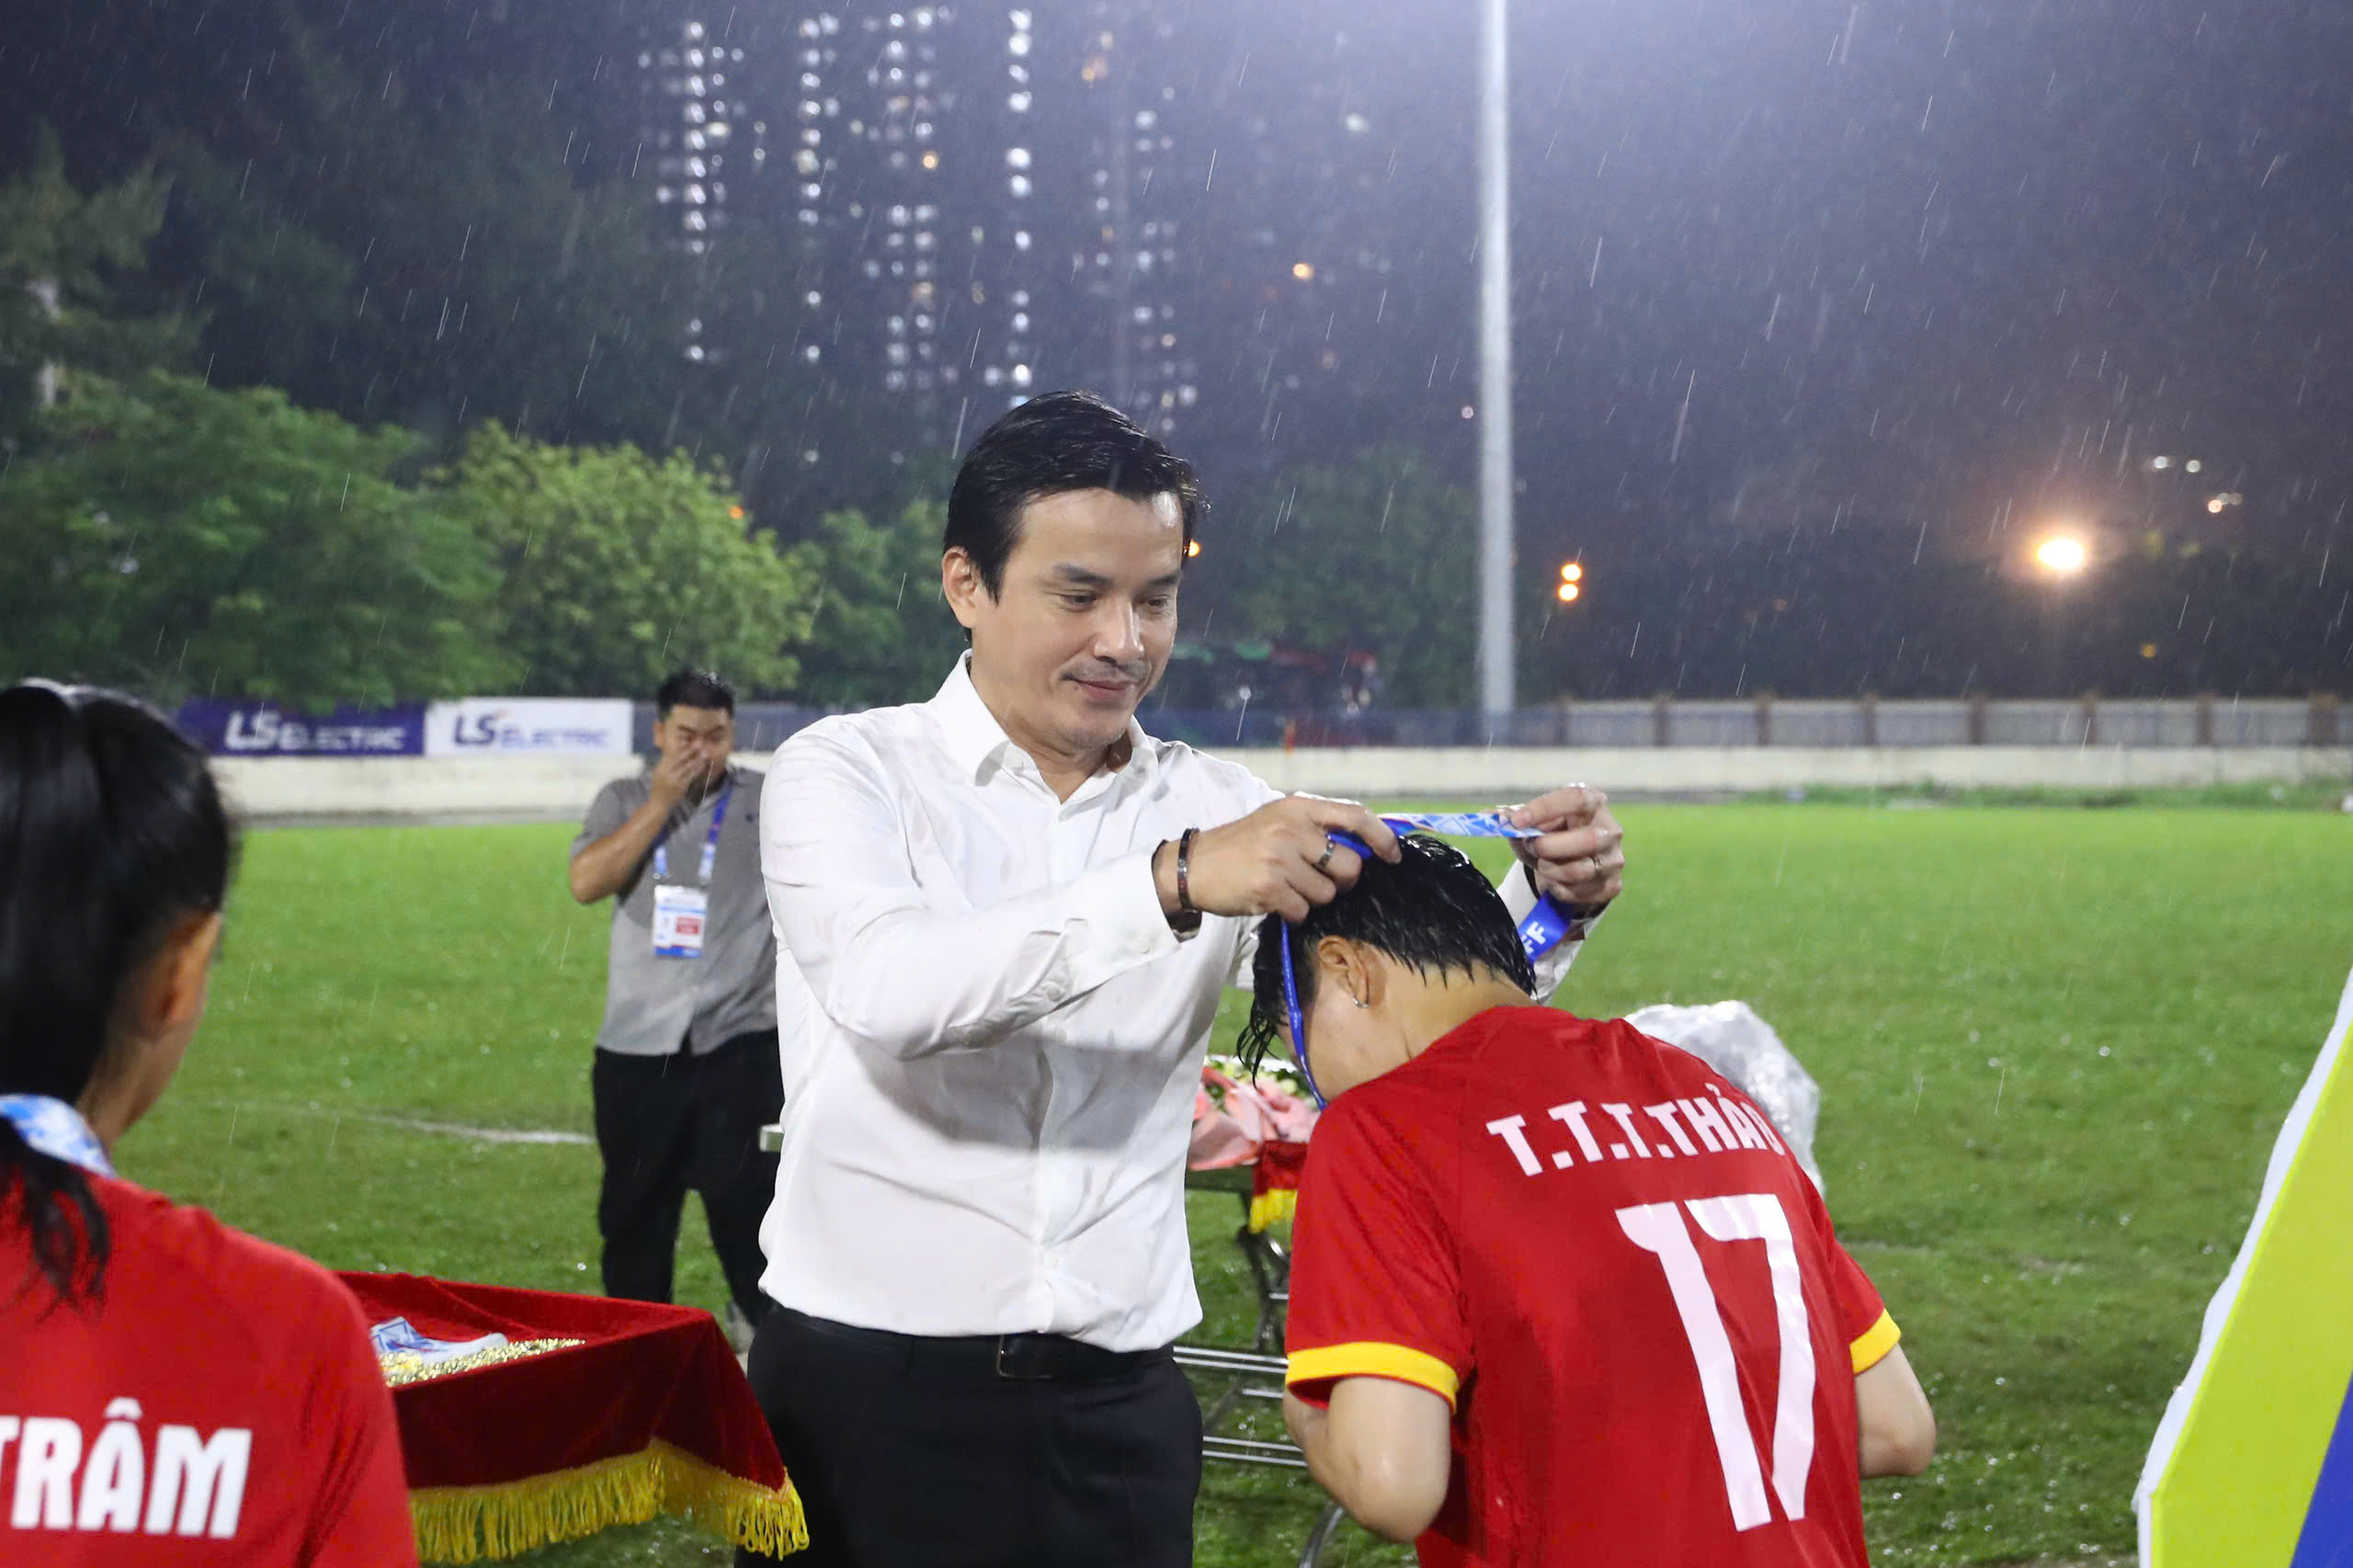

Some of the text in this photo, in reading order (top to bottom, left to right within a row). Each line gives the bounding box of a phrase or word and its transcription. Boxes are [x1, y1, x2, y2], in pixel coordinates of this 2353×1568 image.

[225, 710, 281, 750] LS
[454, 712, 497, 749] LS
[1485, 1082, 1786, 1177] T.T.T.THẢO
[1615, 1193, 1816, 1532] 17
